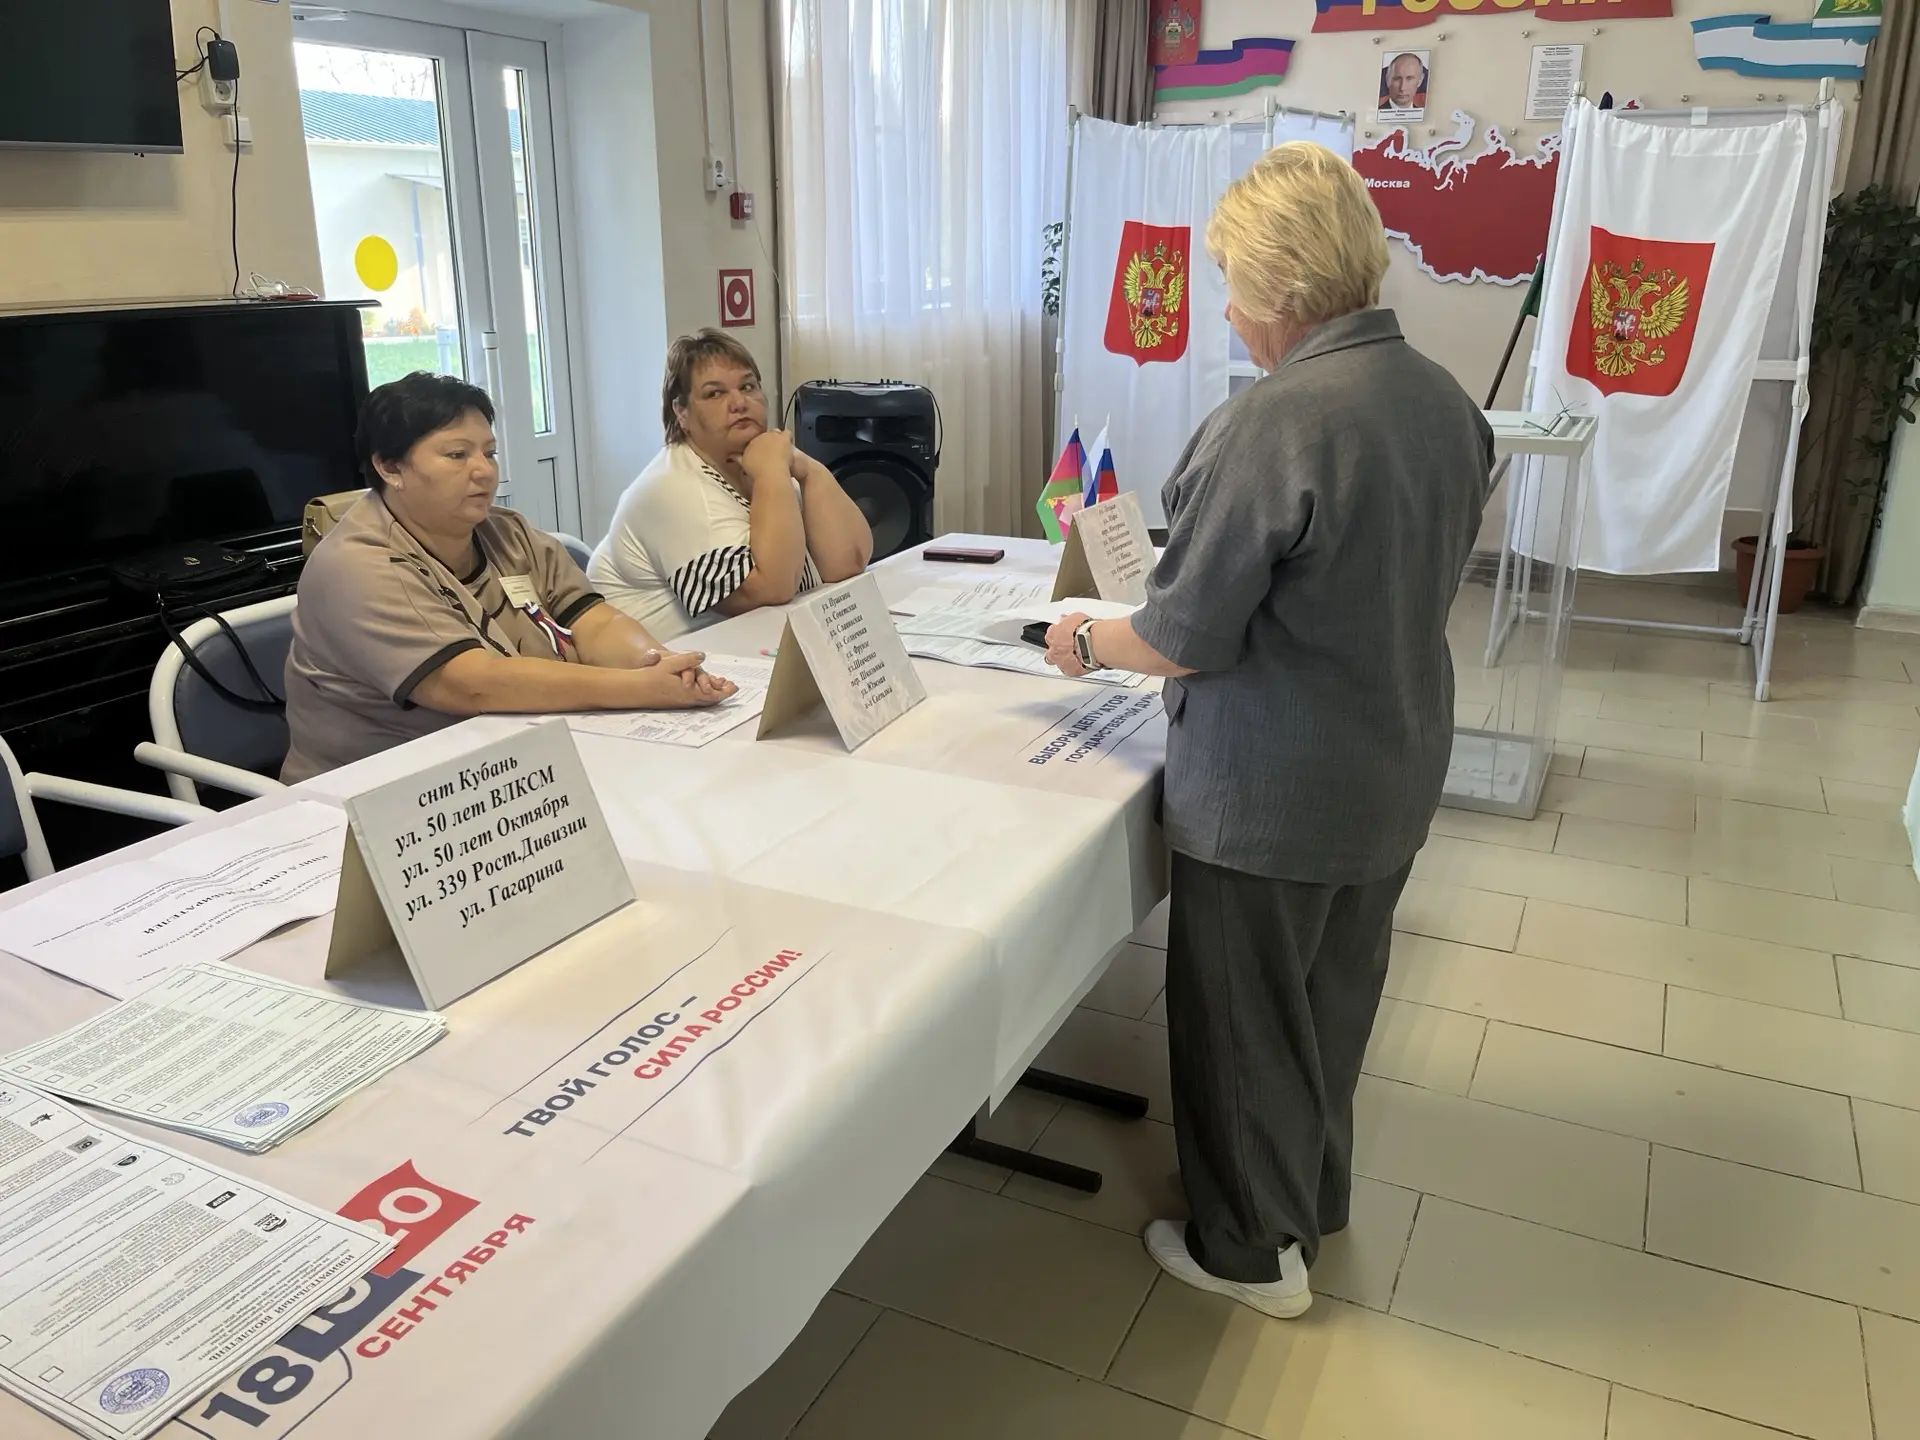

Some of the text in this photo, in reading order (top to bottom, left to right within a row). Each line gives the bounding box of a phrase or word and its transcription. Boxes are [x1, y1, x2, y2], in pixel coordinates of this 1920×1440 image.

[1363, 178, 1411, 188] Москва
[1028, 694, 1129, 765] ВЫБОРЫ ДЕПУАТОВ
[1064, 707, 1140, 763] ГОСУДАРСТВЕНОЙ
[394, 764, 556, 857] ул. 50 лет ВЛКСМ
[417, 755, 519, 808] снт Кубань
[401, 794, 570, 888] ул. 50 лет Октября
[404, 815, 588, 921] ул. 339 Рост.Дивизии
[459, 857, 565, 928] ул. Гагарина
[633, 949, 803, 1080] СИЛА РОССИИ!
[502, 1078, 598, 1138] ТВОЙ
[586, 1011, 681, 1077] ГОЛОС
[355, 1213, 537, 1359] СЕНТЯБРЯ
